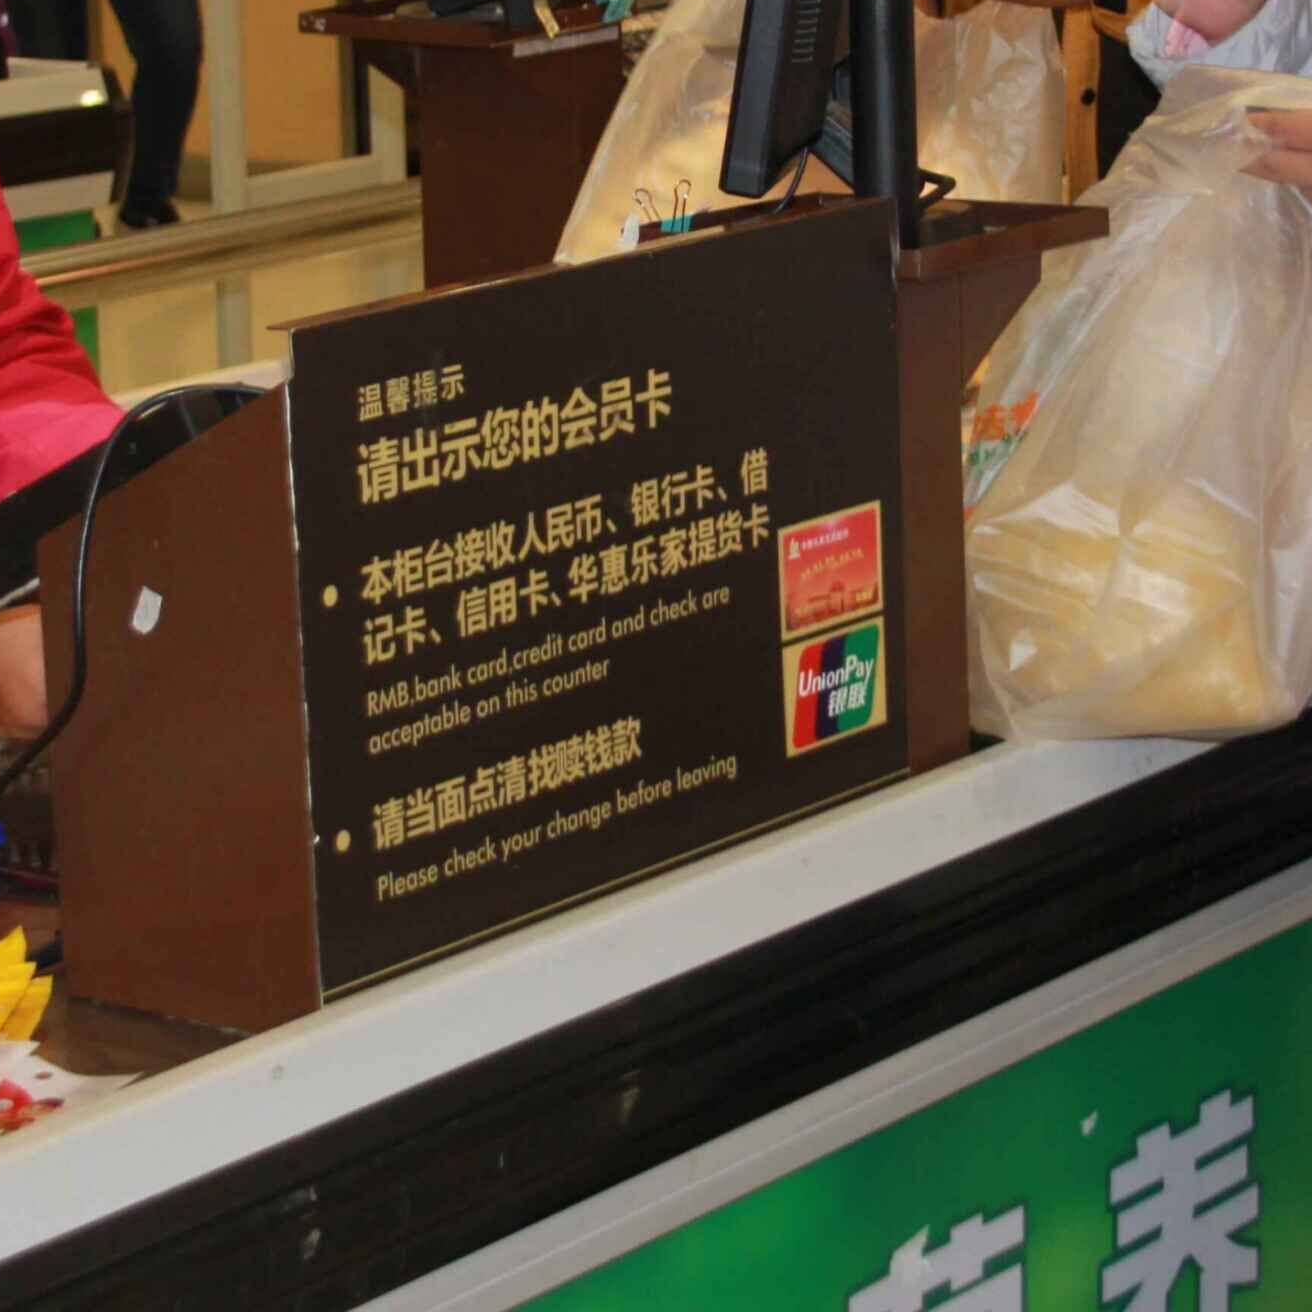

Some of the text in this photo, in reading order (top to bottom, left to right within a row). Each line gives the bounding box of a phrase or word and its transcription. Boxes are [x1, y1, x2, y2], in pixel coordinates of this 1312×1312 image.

[358, 364, 464, 422] 温馨提示
[357, 368, 672, 504] 请出示您的会员卡
[568, 618, 607, 652] card
[611, 607, 645, 638] and
[650, 591, 698, 626] check
[702, 585, 731, 610] are
[369, 657, 610, 755] acceptable on this counter
[799, 653, 875, 698] UnionPay
[828, 685, 866, 718] 银联
[373, 717, 642, 851] 请当面点清找赎钱款
[377, 754, 737, 901] Please check your change before leaving
